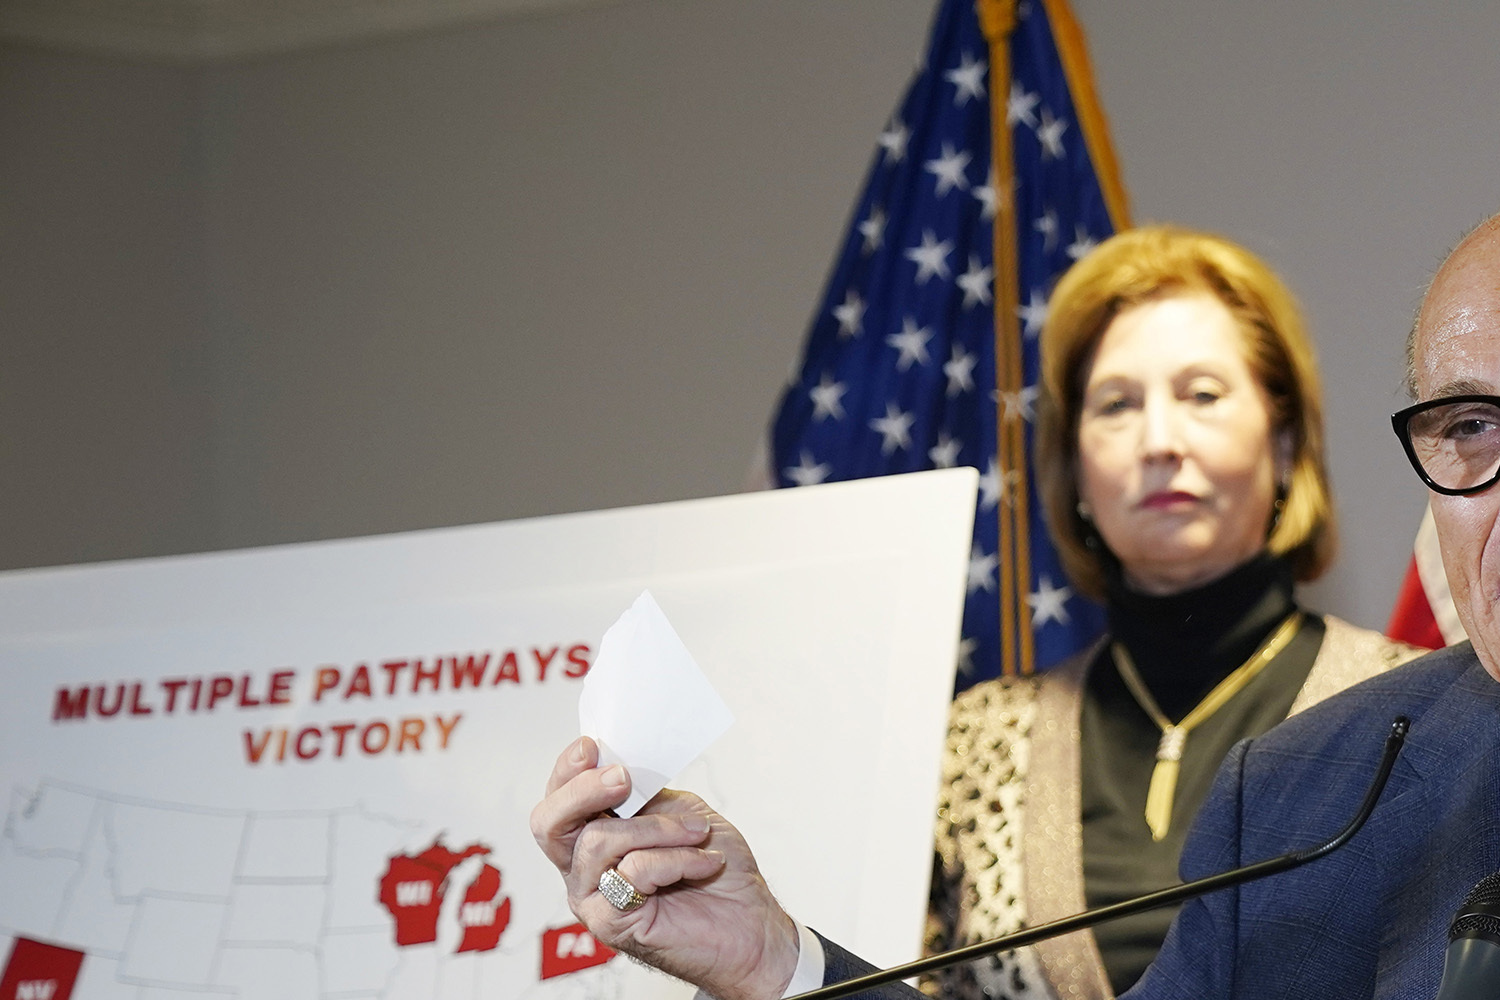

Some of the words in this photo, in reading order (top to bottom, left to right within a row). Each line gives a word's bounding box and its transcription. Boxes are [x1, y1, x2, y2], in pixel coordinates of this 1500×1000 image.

[52, 670, 295, 722] MULTIPLE
[313, 643, 592, 702] PATHWAYS
[243, 713, 463, 763] VICTORY
[396, 880, 433, 906] WI
[462, 901, 495, 926] MI
[556, 932, 596, 958] PA
